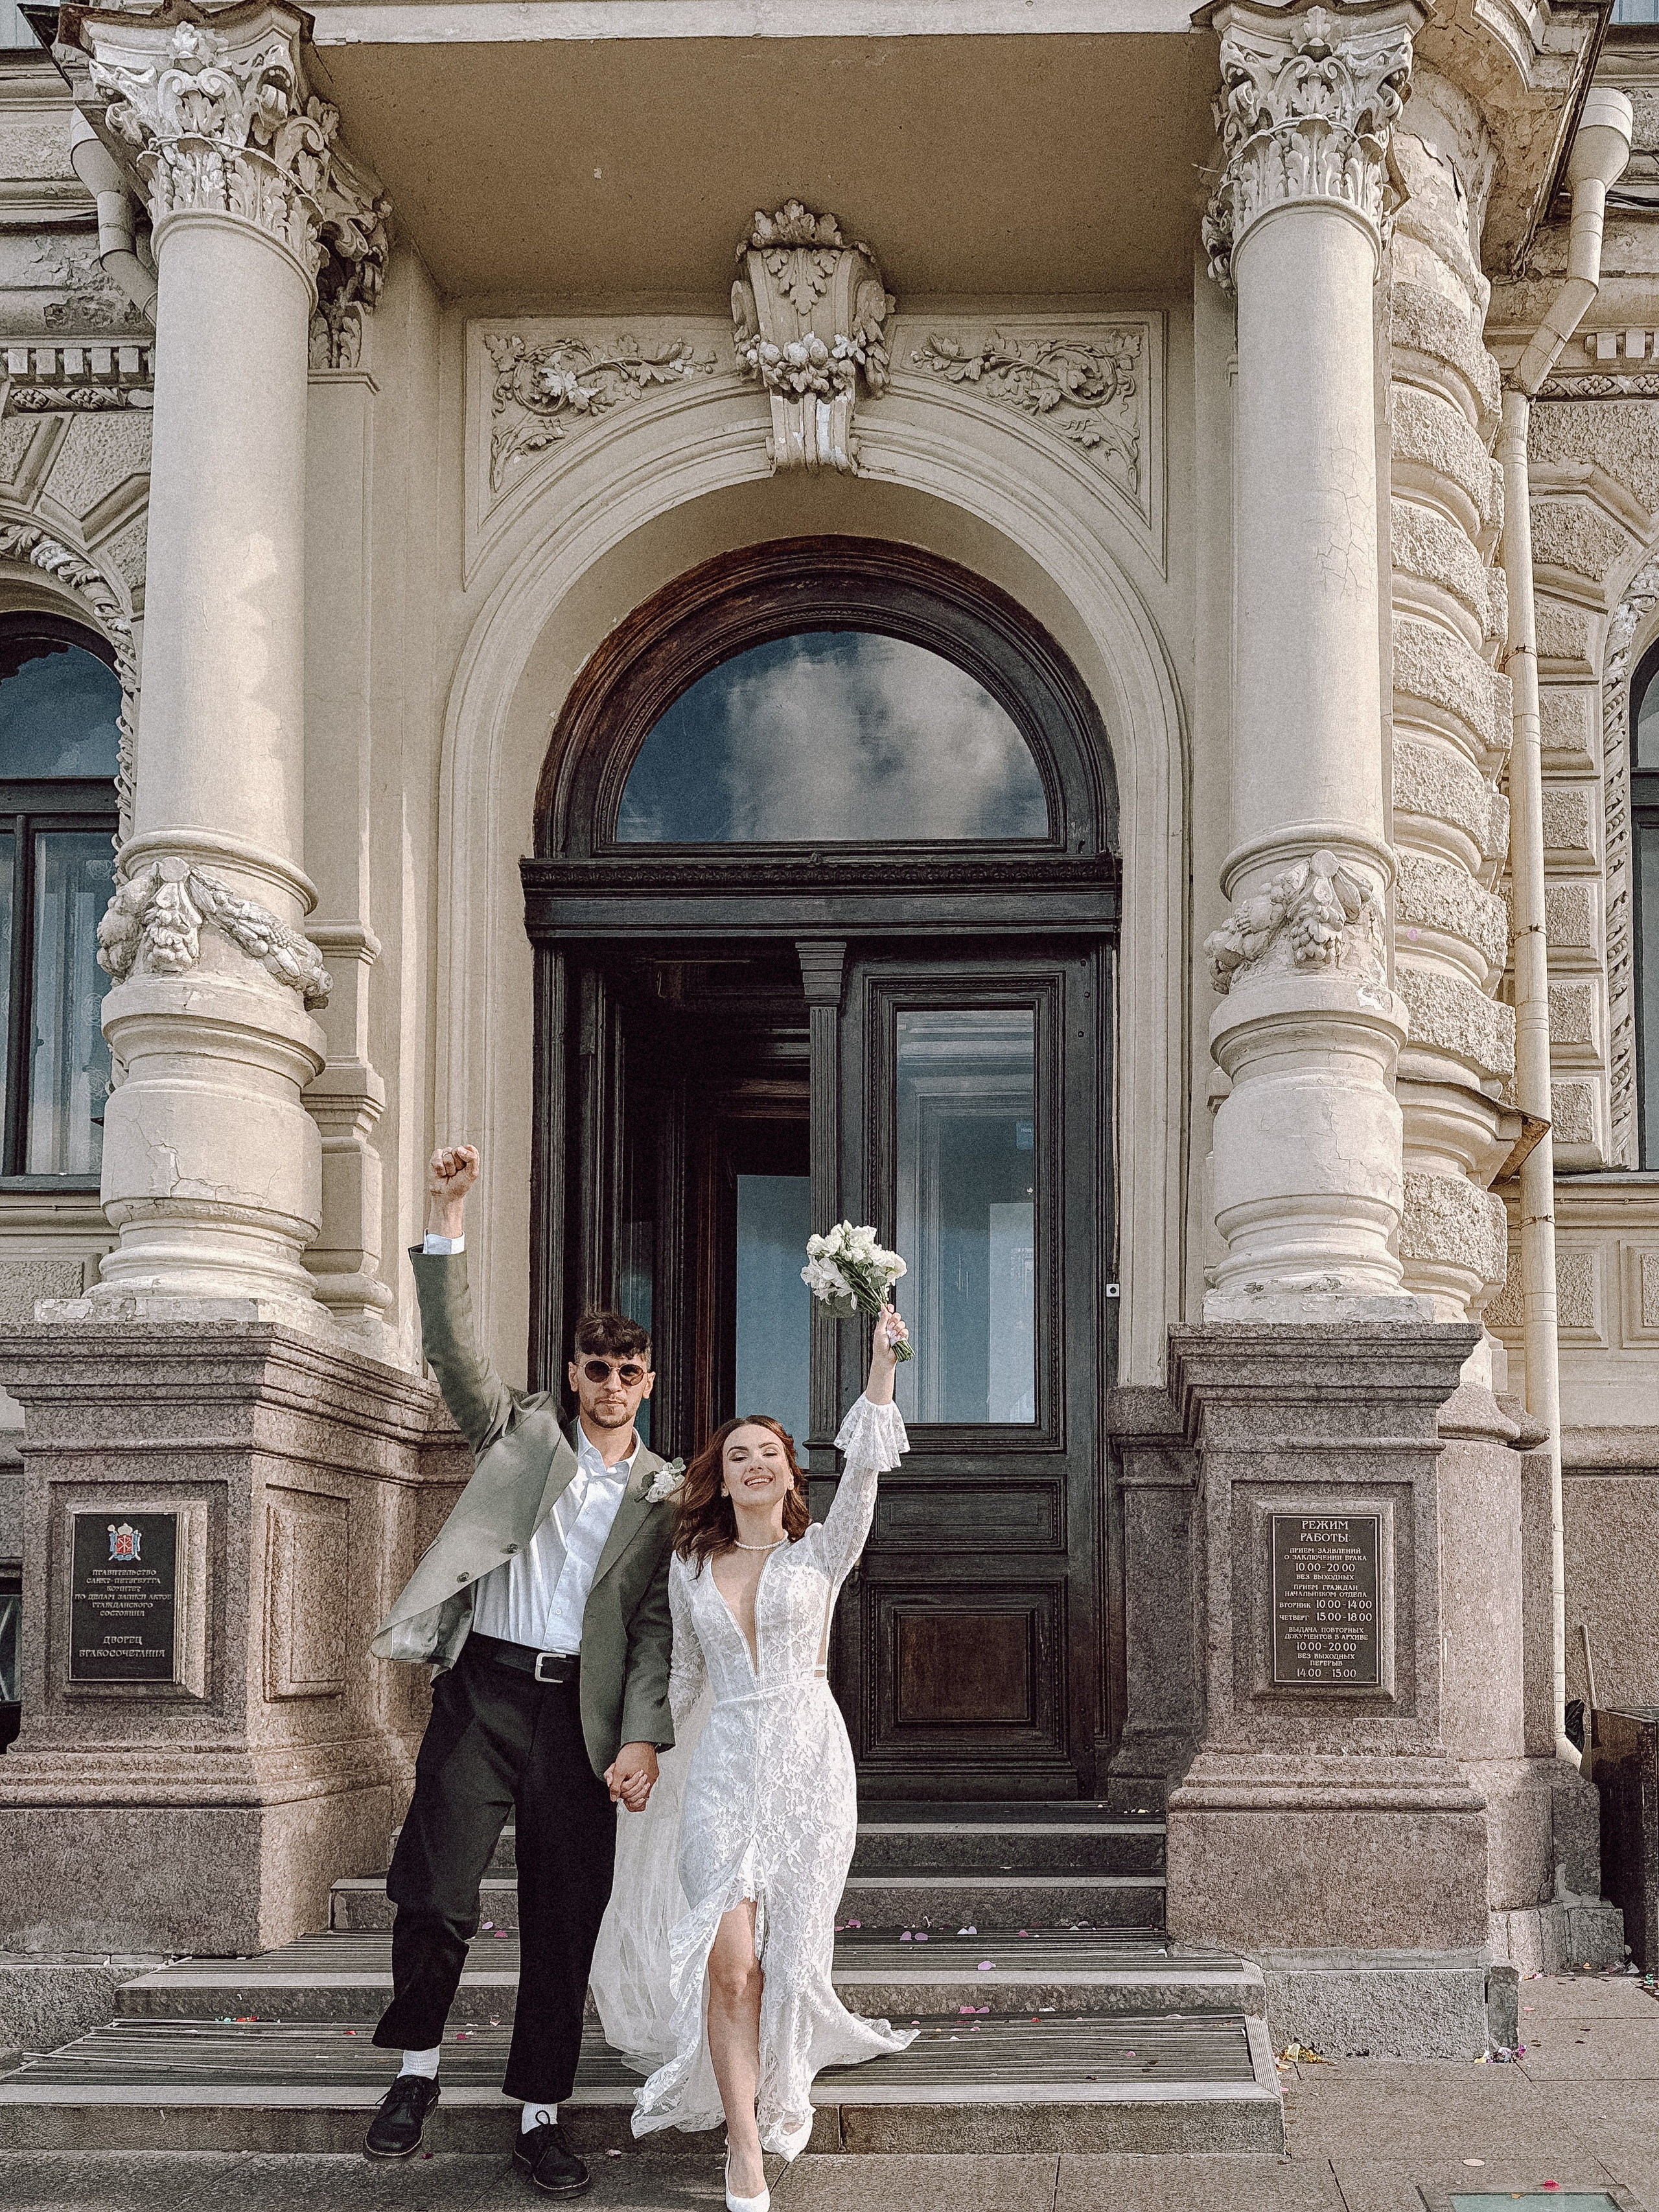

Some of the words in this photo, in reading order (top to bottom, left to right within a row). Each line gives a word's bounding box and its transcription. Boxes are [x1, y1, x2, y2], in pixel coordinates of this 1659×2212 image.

[1302, 1520, 1349, 1530] РЕЖИМ
[1300, 1533, 1351, 1543] РАБОТЫ:
[102, 1636, 143, 1646] ДВОРЕЦ
